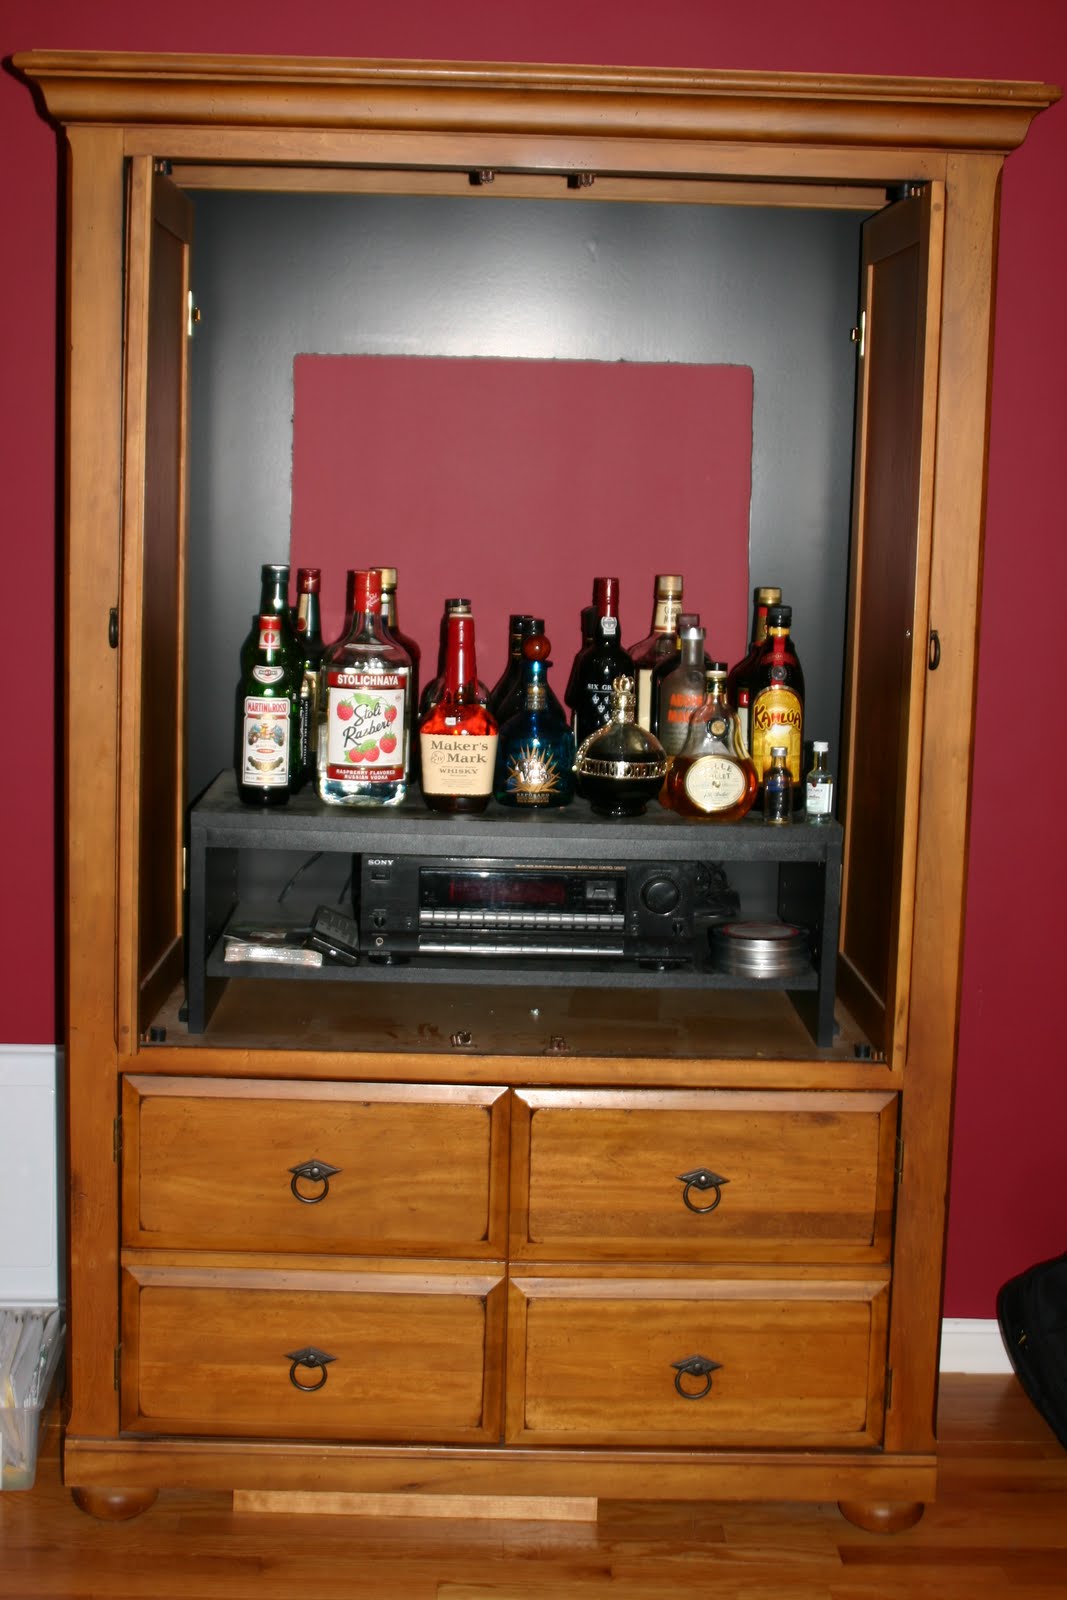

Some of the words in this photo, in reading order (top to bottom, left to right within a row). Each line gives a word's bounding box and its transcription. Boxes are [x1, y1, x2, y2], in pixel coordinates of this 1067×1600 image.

[337, 674, 399, 686] STOLICHNAYA
[353, 702, 382, 727] Stoli
[754, 705, 801, 730] KAHLÚA
[342, 716, 391, 748] Razberi
[430, 740, 489, 751] Maker's
[447, 753, 488, 763] Mark
